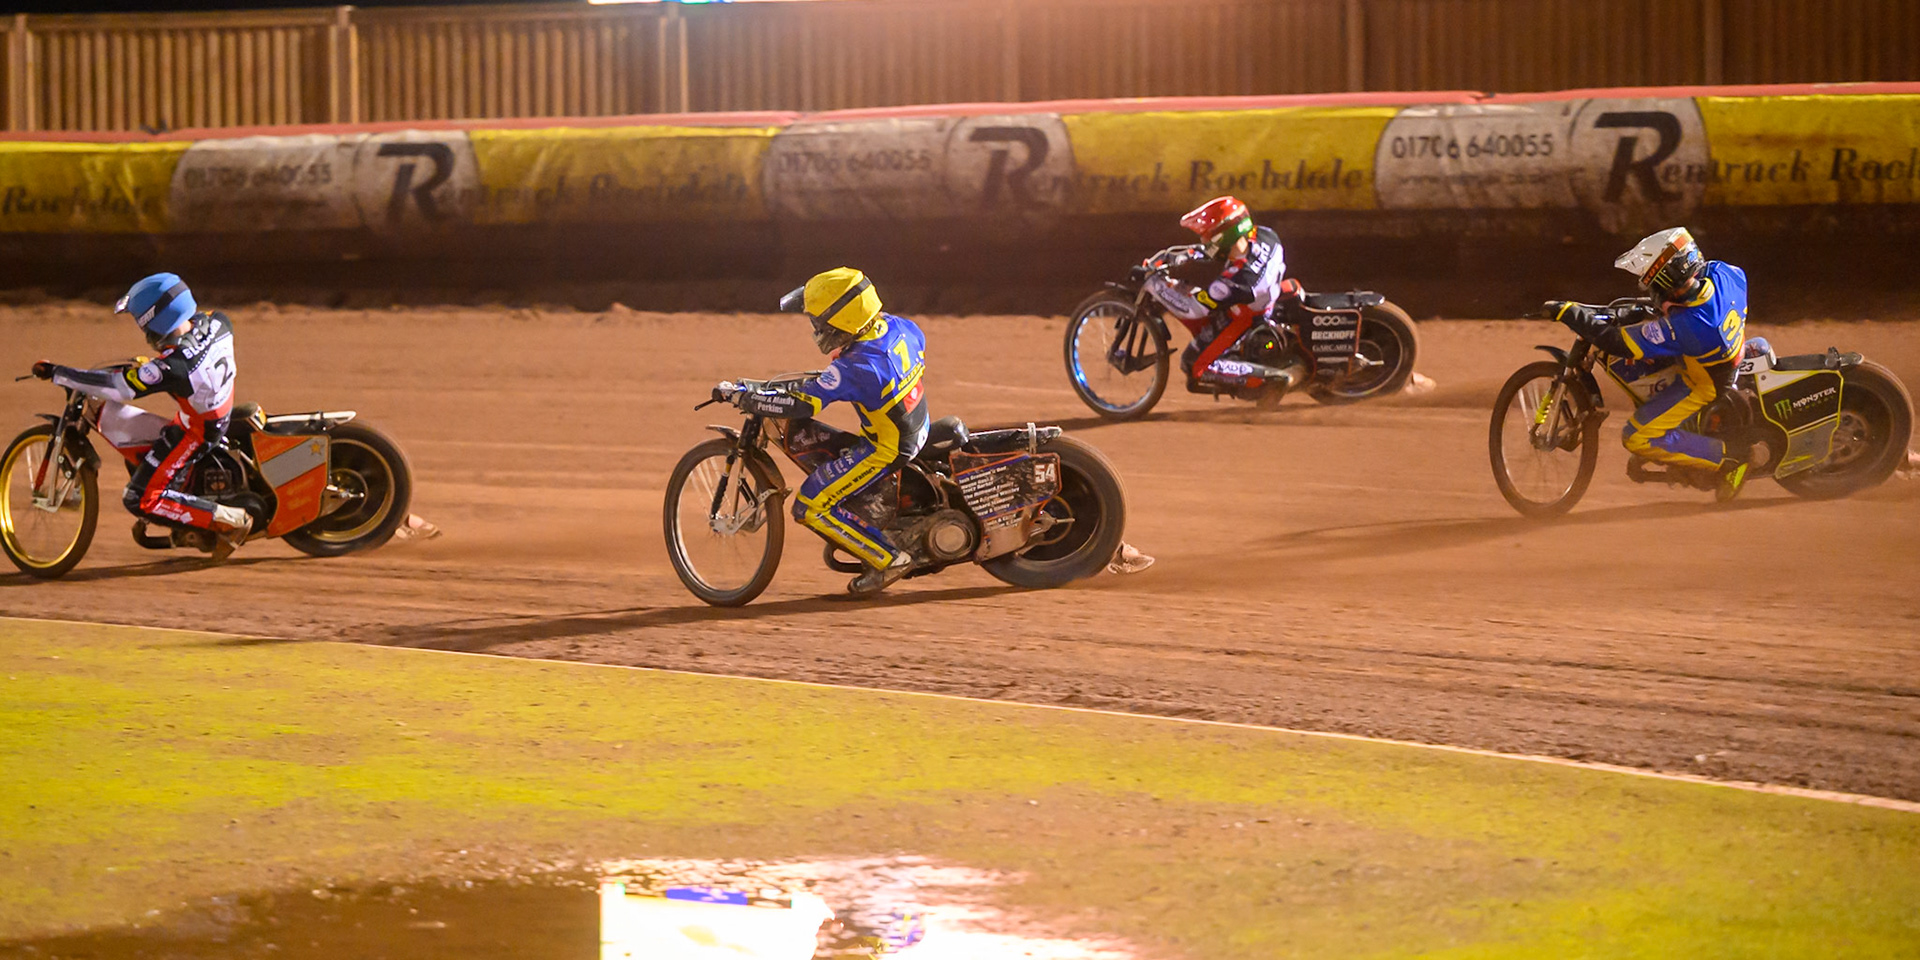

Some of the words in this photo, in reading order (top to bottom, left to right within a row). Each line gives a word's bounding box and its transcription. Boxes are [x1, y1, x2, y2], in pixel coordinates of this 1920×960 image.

[1391, 135, 1460, 159] 01706
[1466, 133, 1553, 158] 640055
[1188, 158, 1364, 191] Rochdale
[1311, 330, 1355, 340] BECKHOFF
[1722, 309, 1741, 341] 3
[213, 356, 233, 388] 2
[757, 403, 783, 414] Perkins
[1792, 387, 1836, 408] MONSTER
[1035, 463, 1055, 483] 54
